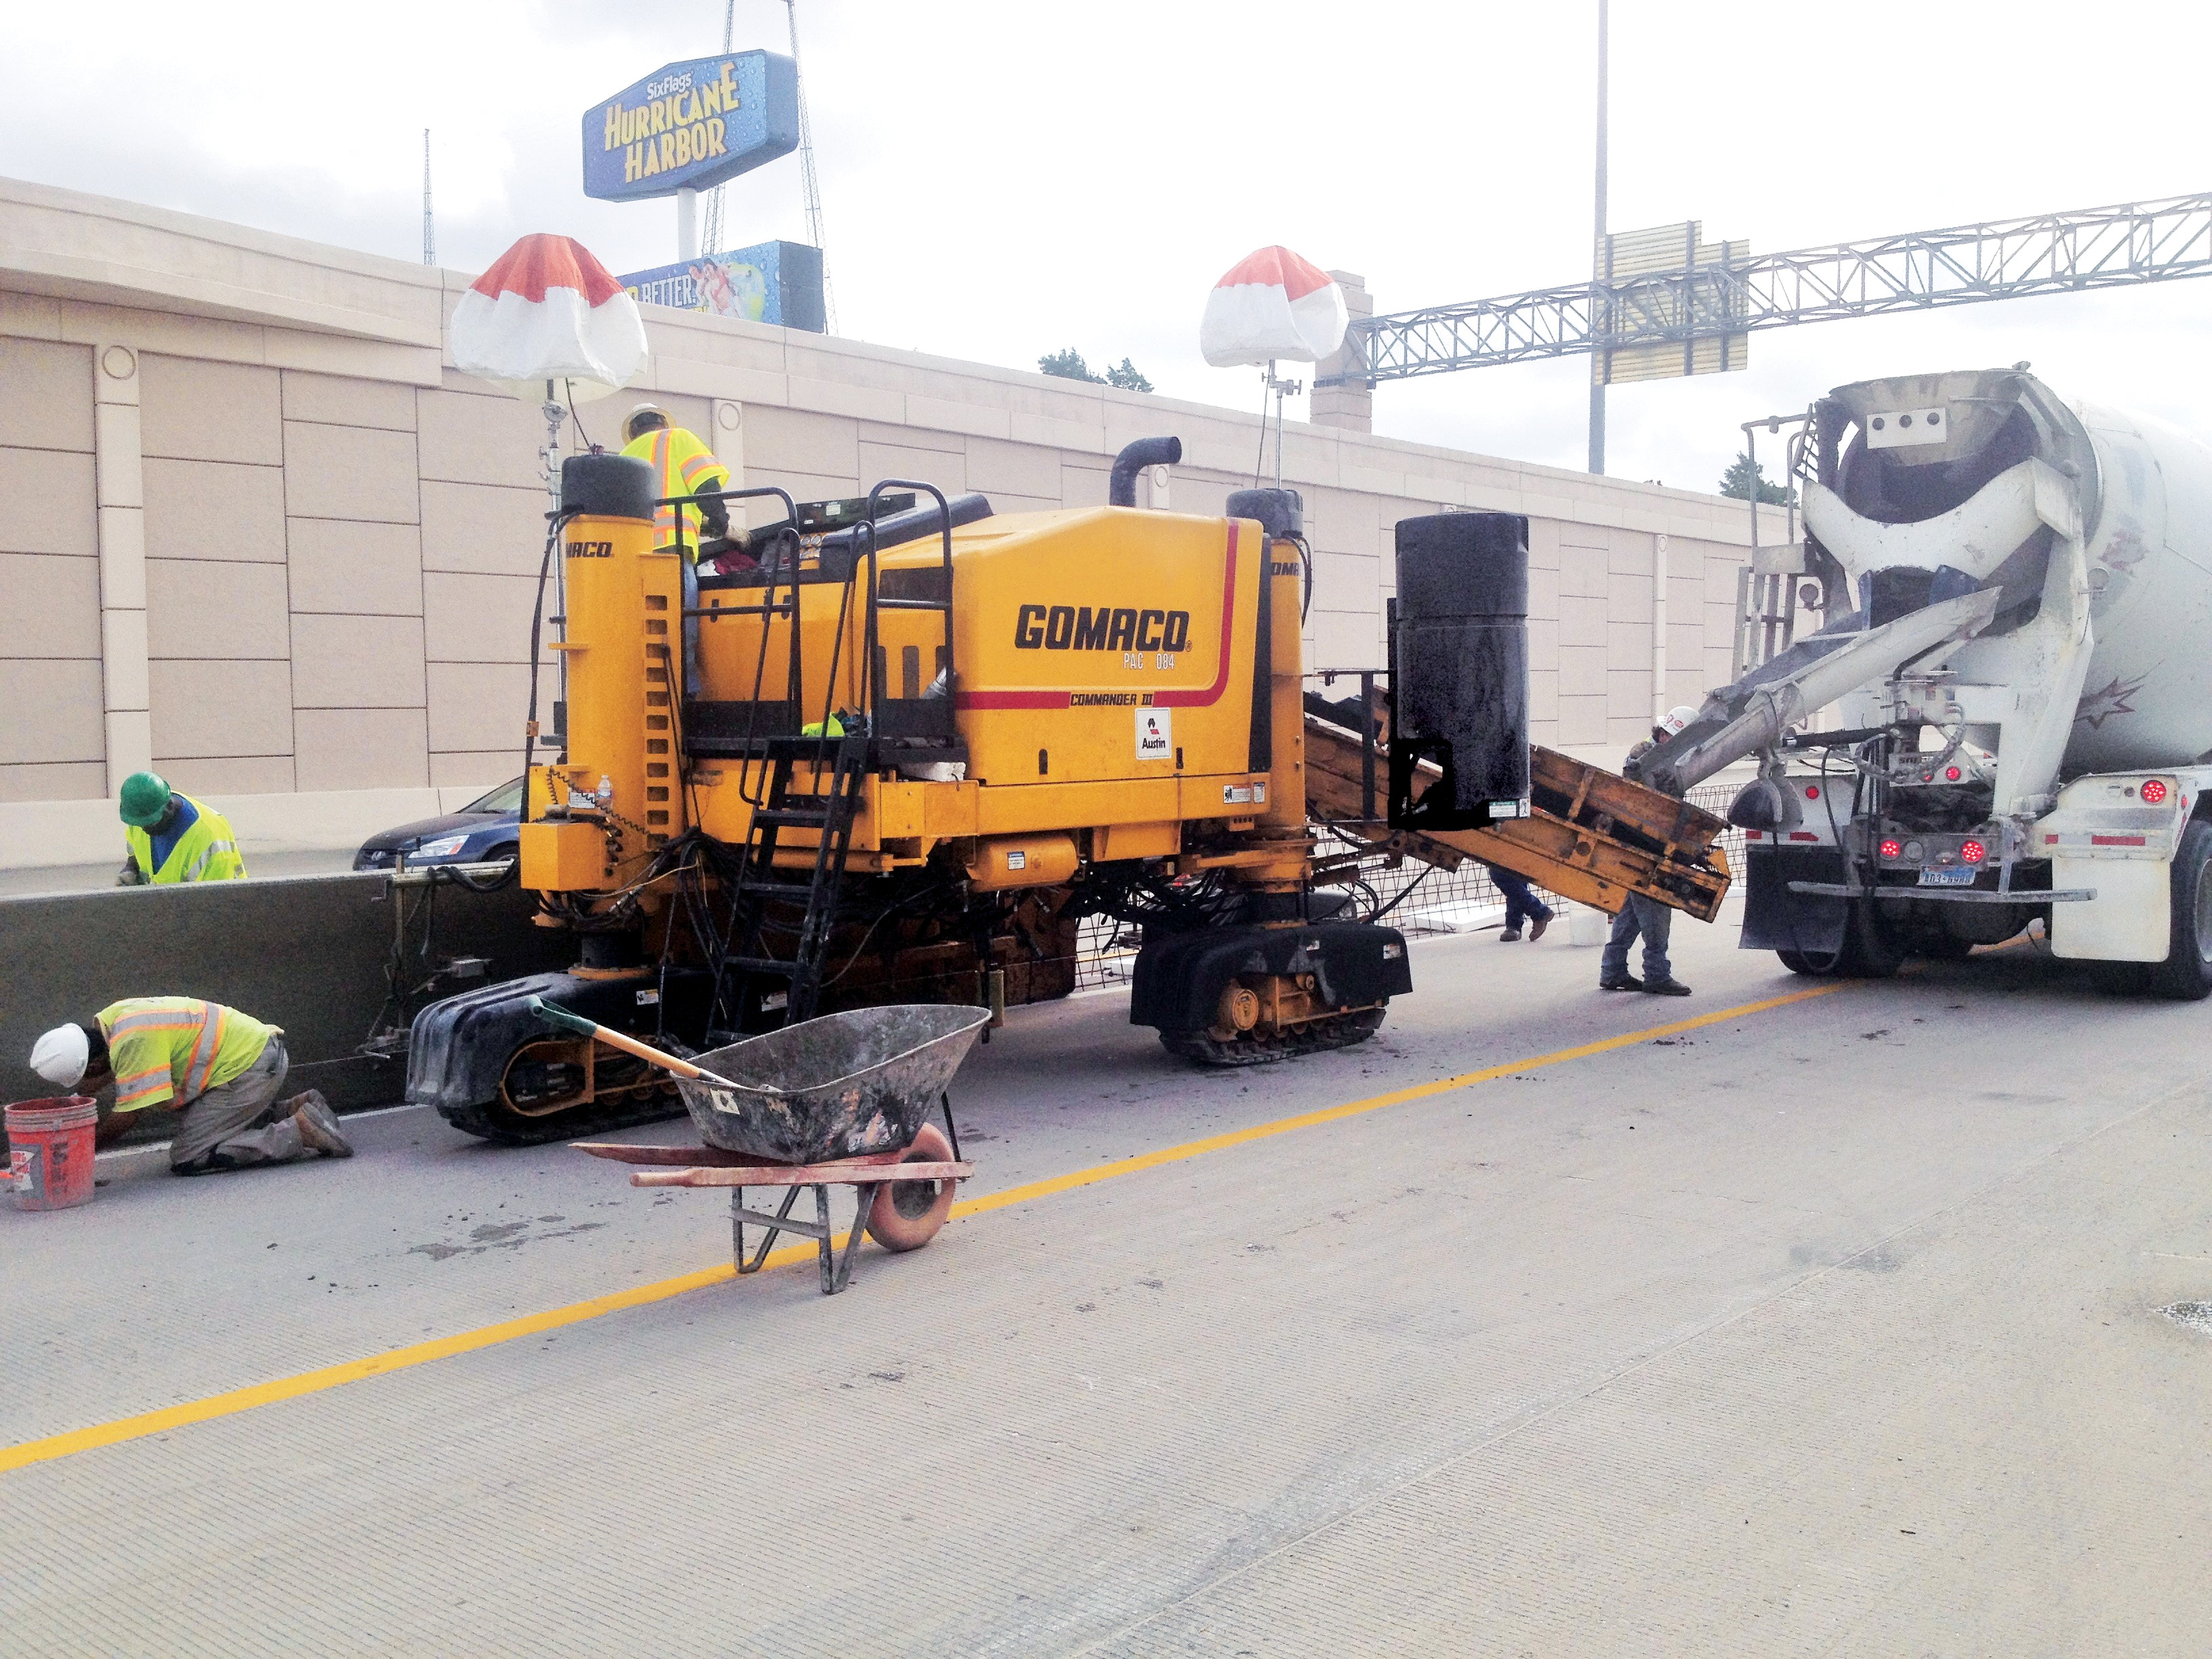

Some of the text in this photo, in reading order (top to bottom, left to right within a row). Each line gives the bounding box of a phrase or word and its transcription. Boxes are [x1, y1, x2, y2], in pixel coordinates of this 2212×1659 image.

[605, 61, 739, 151] HURRICANE
[624, 117, 727, 184] HARBOR
[1015, 604, 1189, 652] GOMACO
[1123, 651, 1175, 670] PAC 084
[1070, 693, 1137, 706] COMMANDER
[1142, 737, 1166, 752] Austin
